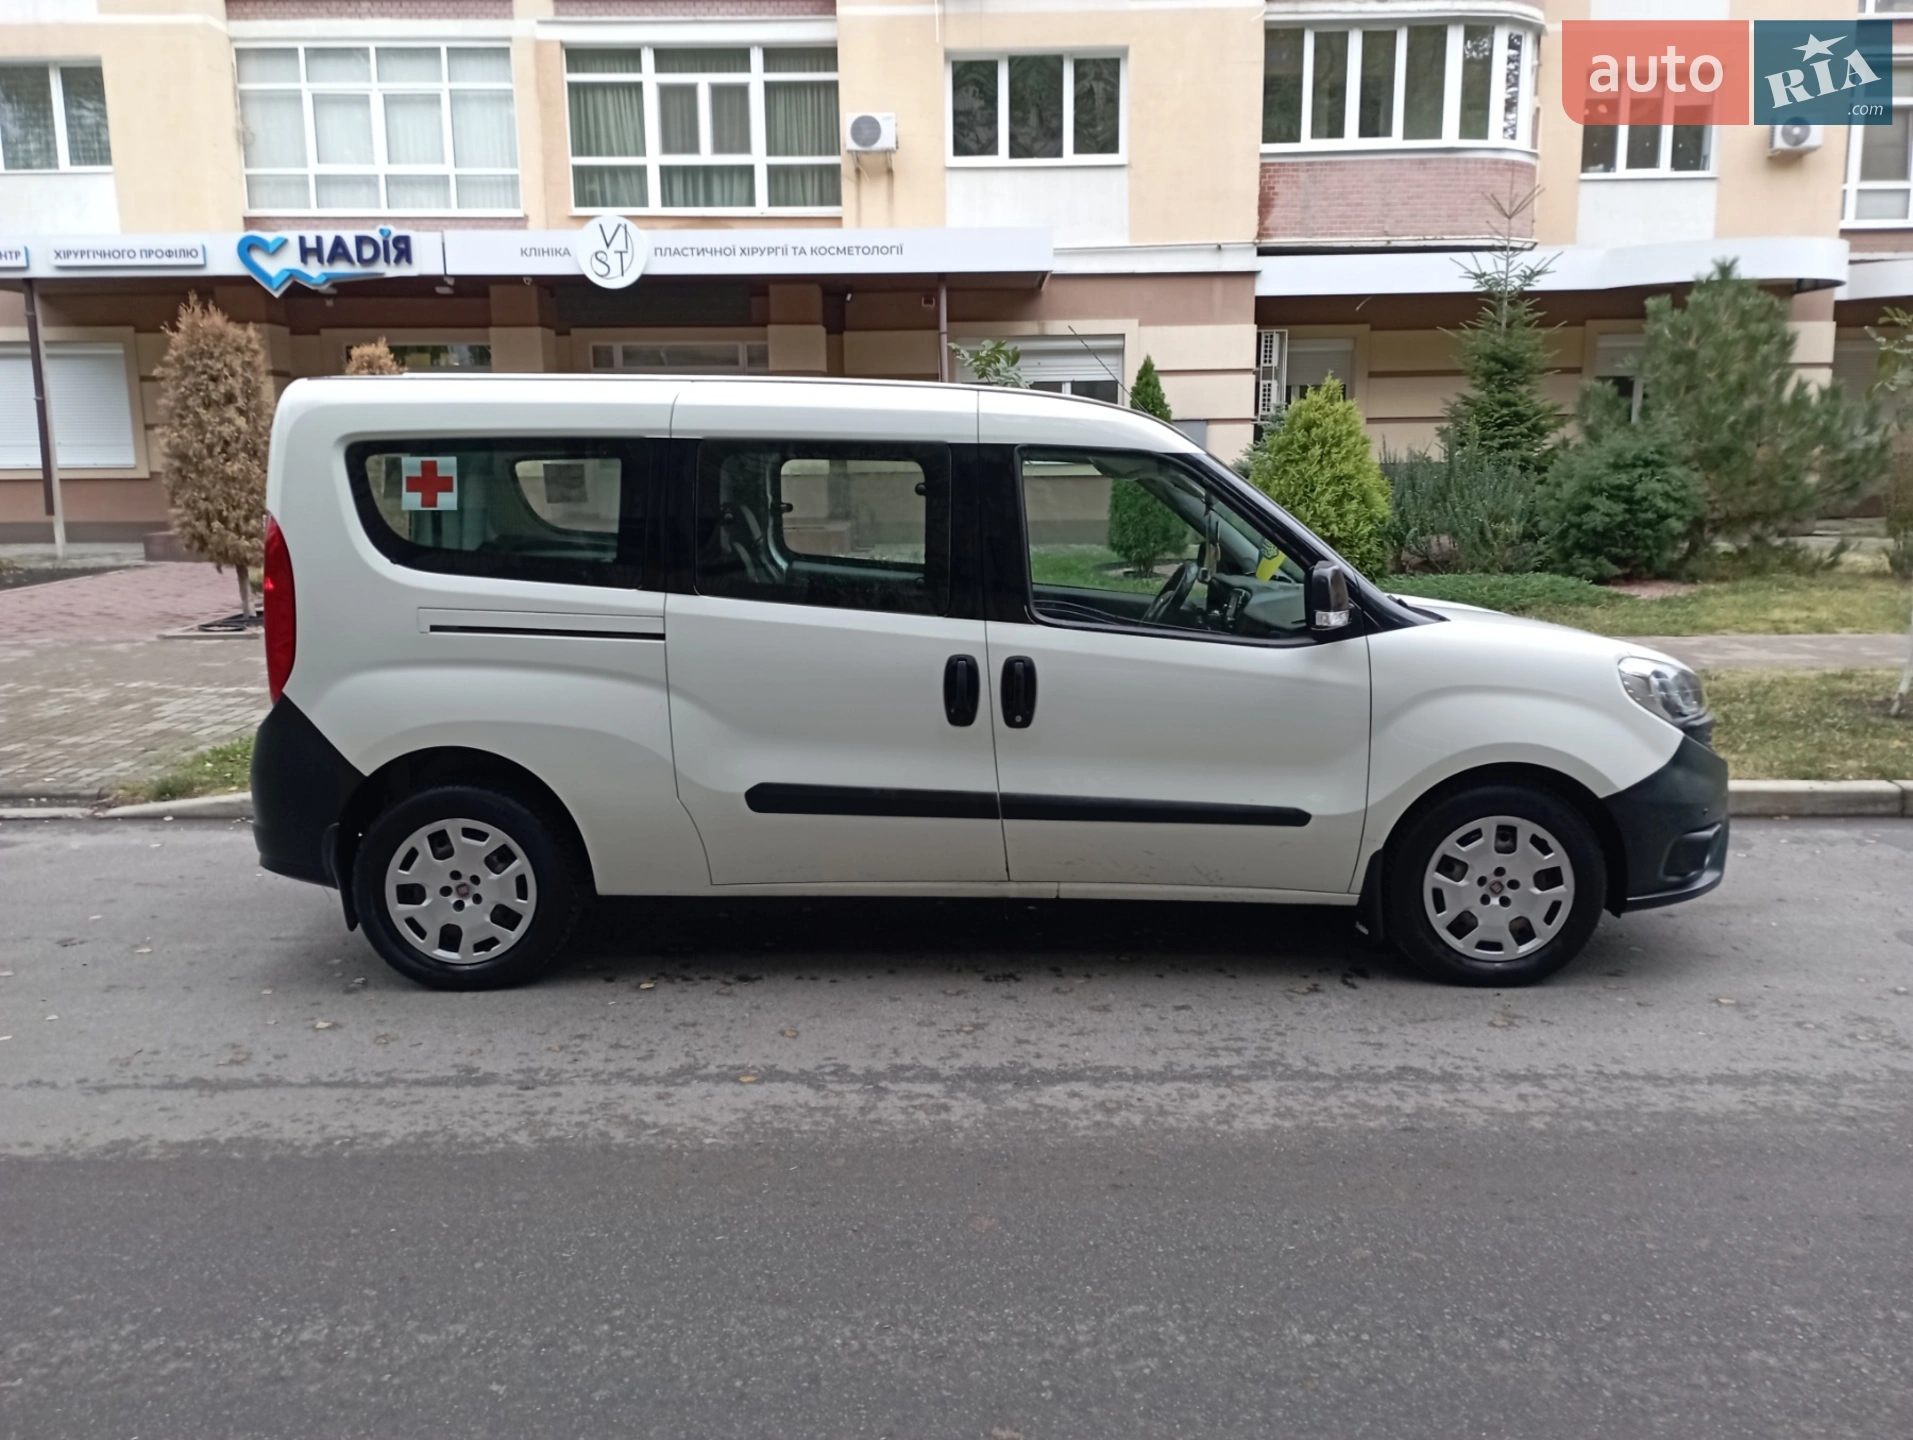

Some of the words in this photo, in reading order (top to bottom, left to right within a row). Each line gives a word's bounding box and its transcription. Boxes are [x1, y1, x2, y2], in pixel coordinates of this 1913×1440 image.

[54, 249, 137, 261] ХІРУРГІЧНОГО
[139, 247, 199, 260] ПРОФІЛЮ
[520, 246, 572, 258] КЛІНІКА
[654, 245, 737, 258] ПЛАСТИЧНОЇ
[739, 244, 789, 257] ХІРУРГІЇ
[791, 246, 808, 257] ТА
[810, 243, 904, 256] КОСМЕТОЛОГІЇ
